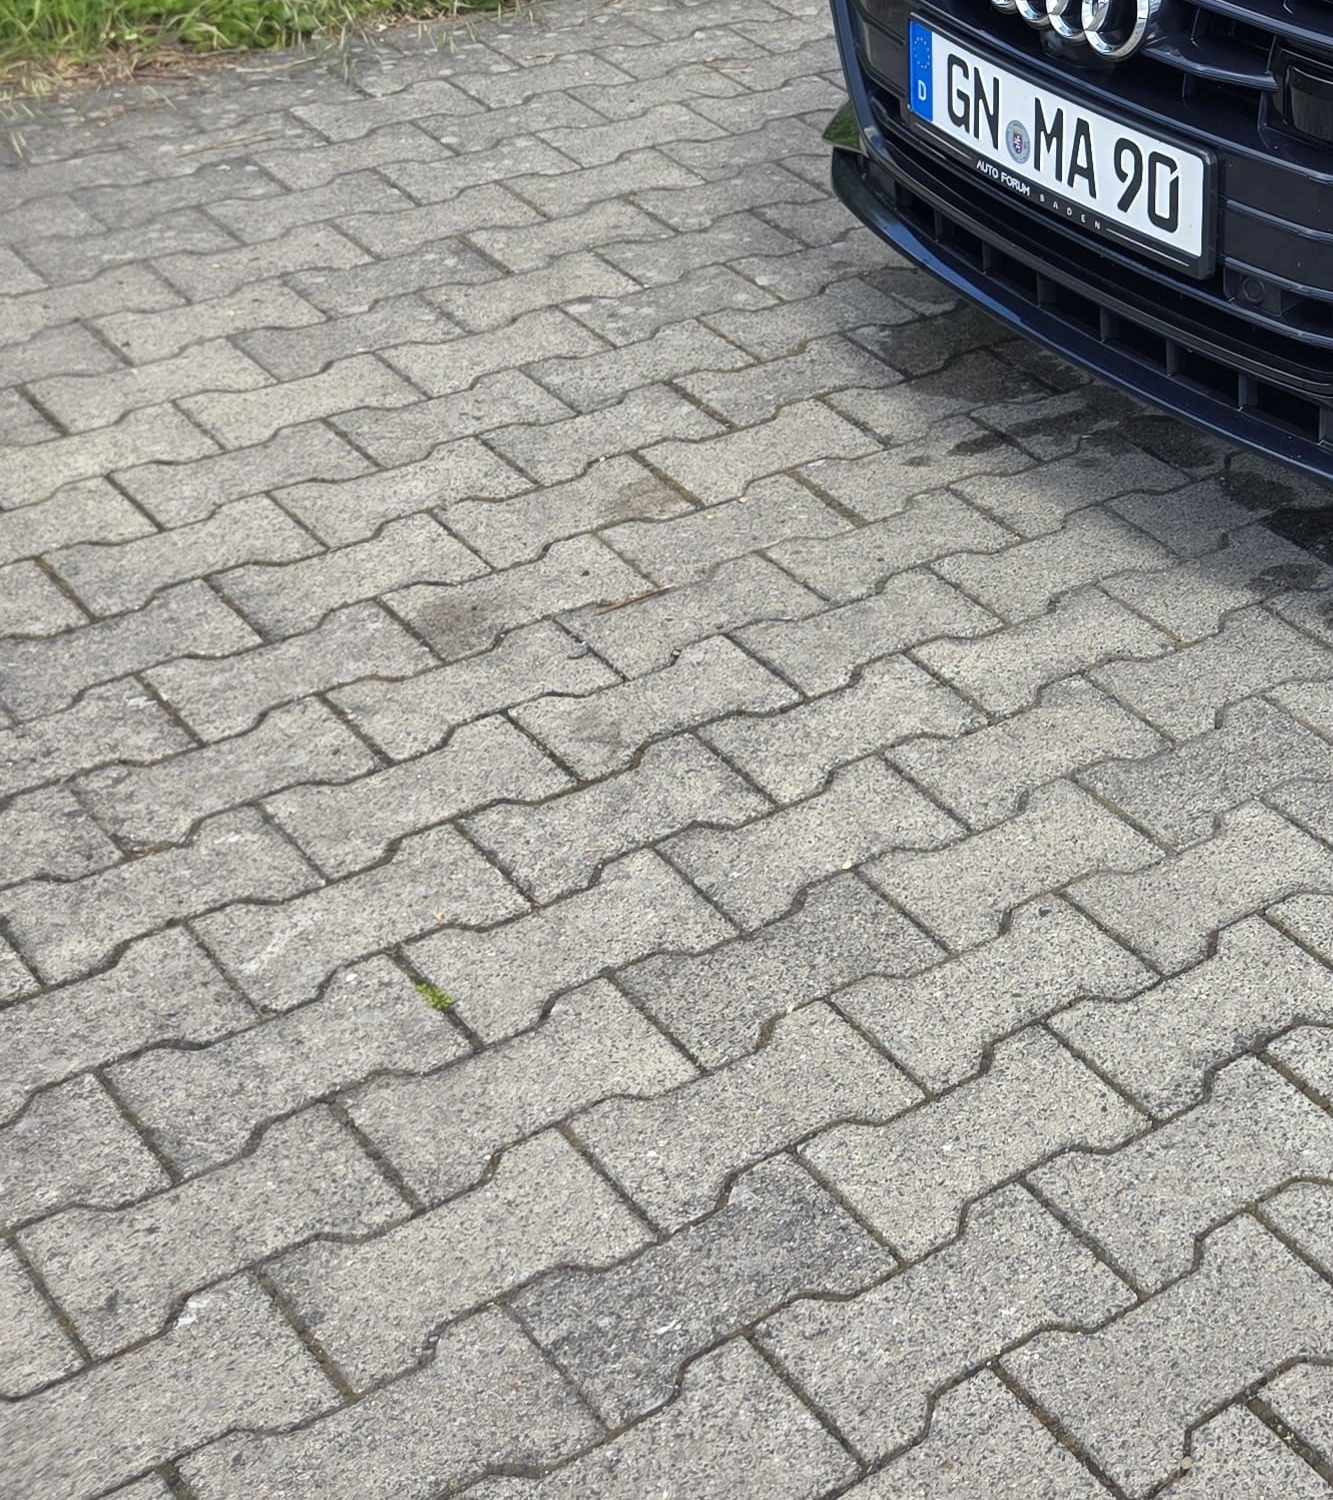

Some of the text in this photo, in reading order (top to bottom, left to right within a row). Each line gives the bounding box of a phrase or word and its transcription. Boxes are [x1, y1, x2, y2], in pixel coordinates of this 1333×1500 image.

[918, 80, 928, 101] D
[947, 53, 1180, 233] GN MA 90
[976, 159, 1101, 230] AUTO FORUM BADEN
